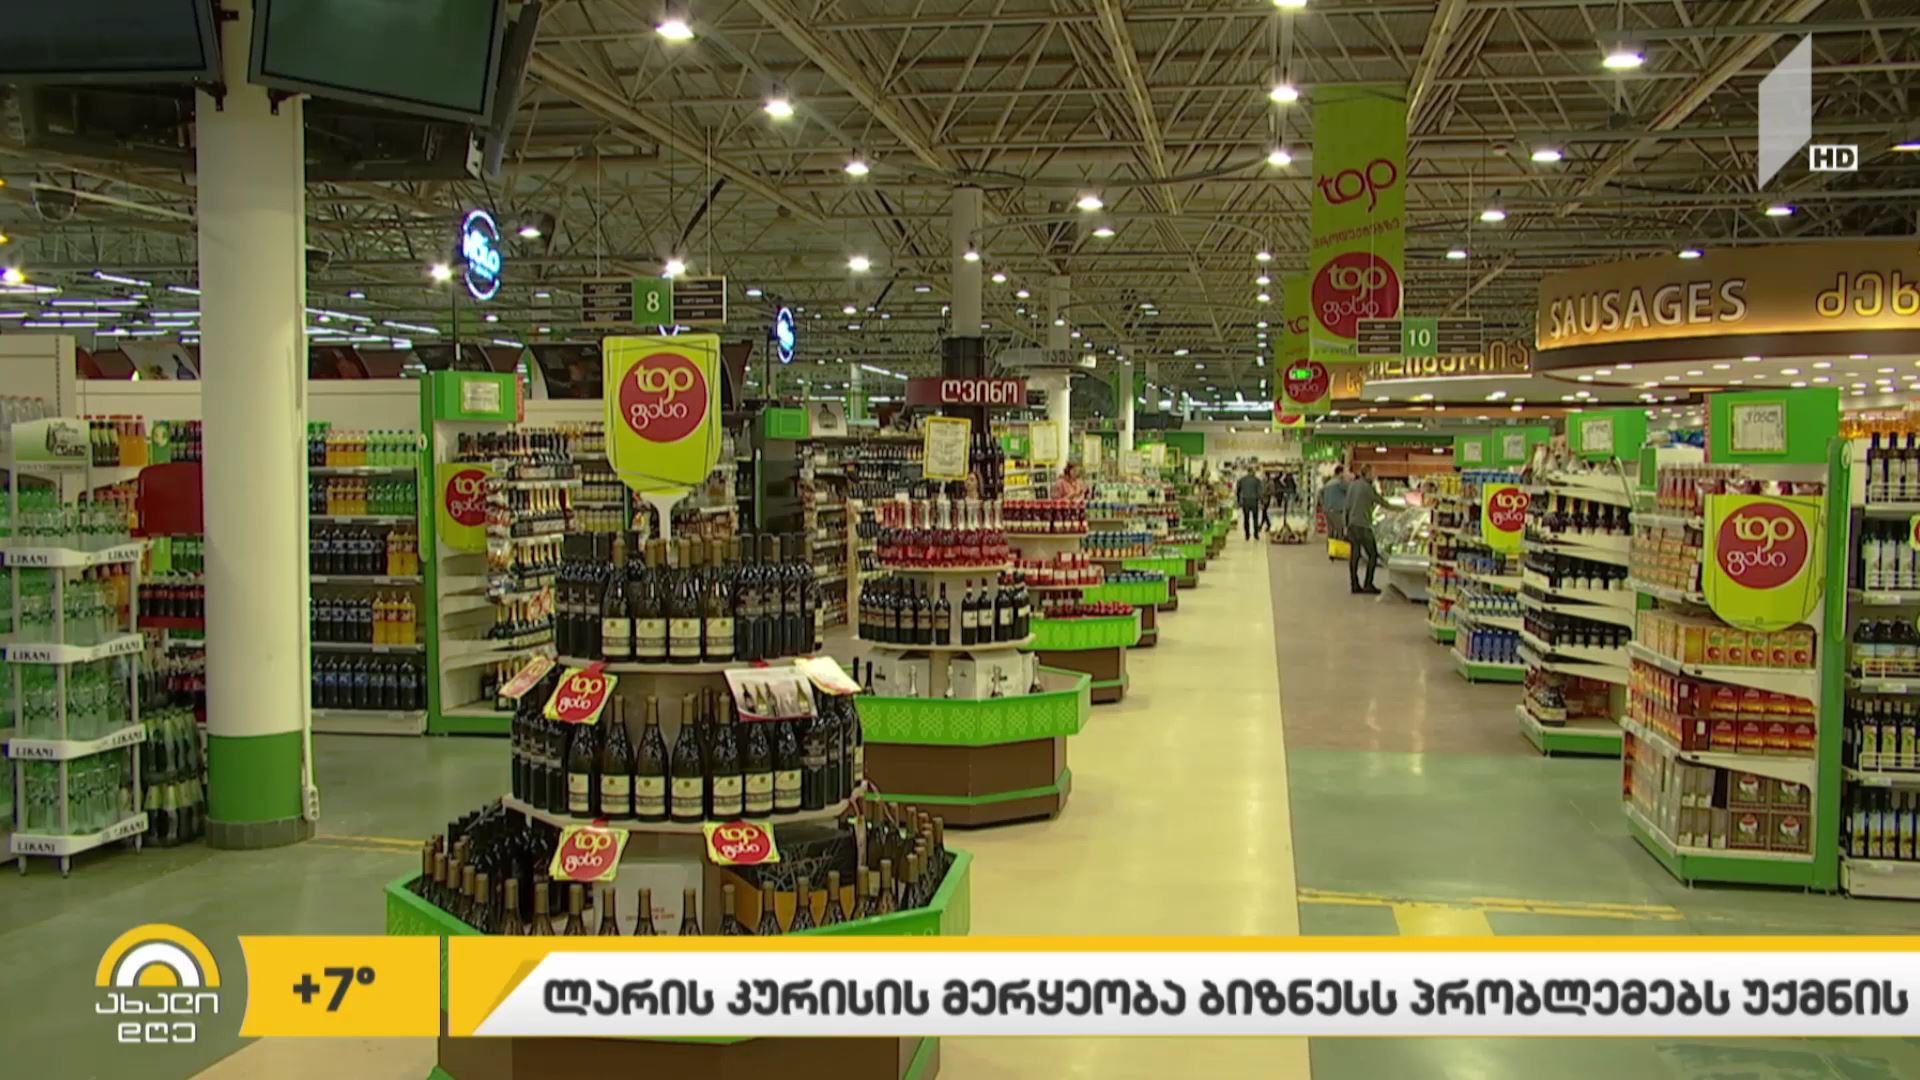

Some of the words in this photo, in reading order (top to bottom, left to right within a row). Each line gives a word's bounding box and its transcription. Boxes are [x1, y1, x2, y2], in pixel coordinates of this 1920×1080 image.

[1317, 158, 1398, 213] top
[1328, 263, 1388, 302] top
[645, 290, 661, 313] 8
[1323, 295, 1379, 325] ფასი
[1550, 278, 1748, 340] SAUSAGES
[1408, 328, 1431, 348] 10
[634, 365, 695, 403] top
[941, 380, 1019, 405] ღვინო
[630, 398, 688, 430] ფასი
[1497, 493, 1528, 512] top
[1732, 513, 1796, 551] top
[10, 554, 48, 565] LIKANI
[108, 549, 139, 561] LIKANI
[1726, 546, 1787, 576] ფასი
[13, 650, 51, 662] LIKANI
[109, 640, 140, 654] LIKANI
[570, 675, 603, 701] top
[112, 730, 143, 746] LIKANI
[16, 747, 54, 758] LIKANI
[574, 829, 612, 856] top
[718, 824, 760, 845] top
[17, 842, 56, 853] LIKANI
